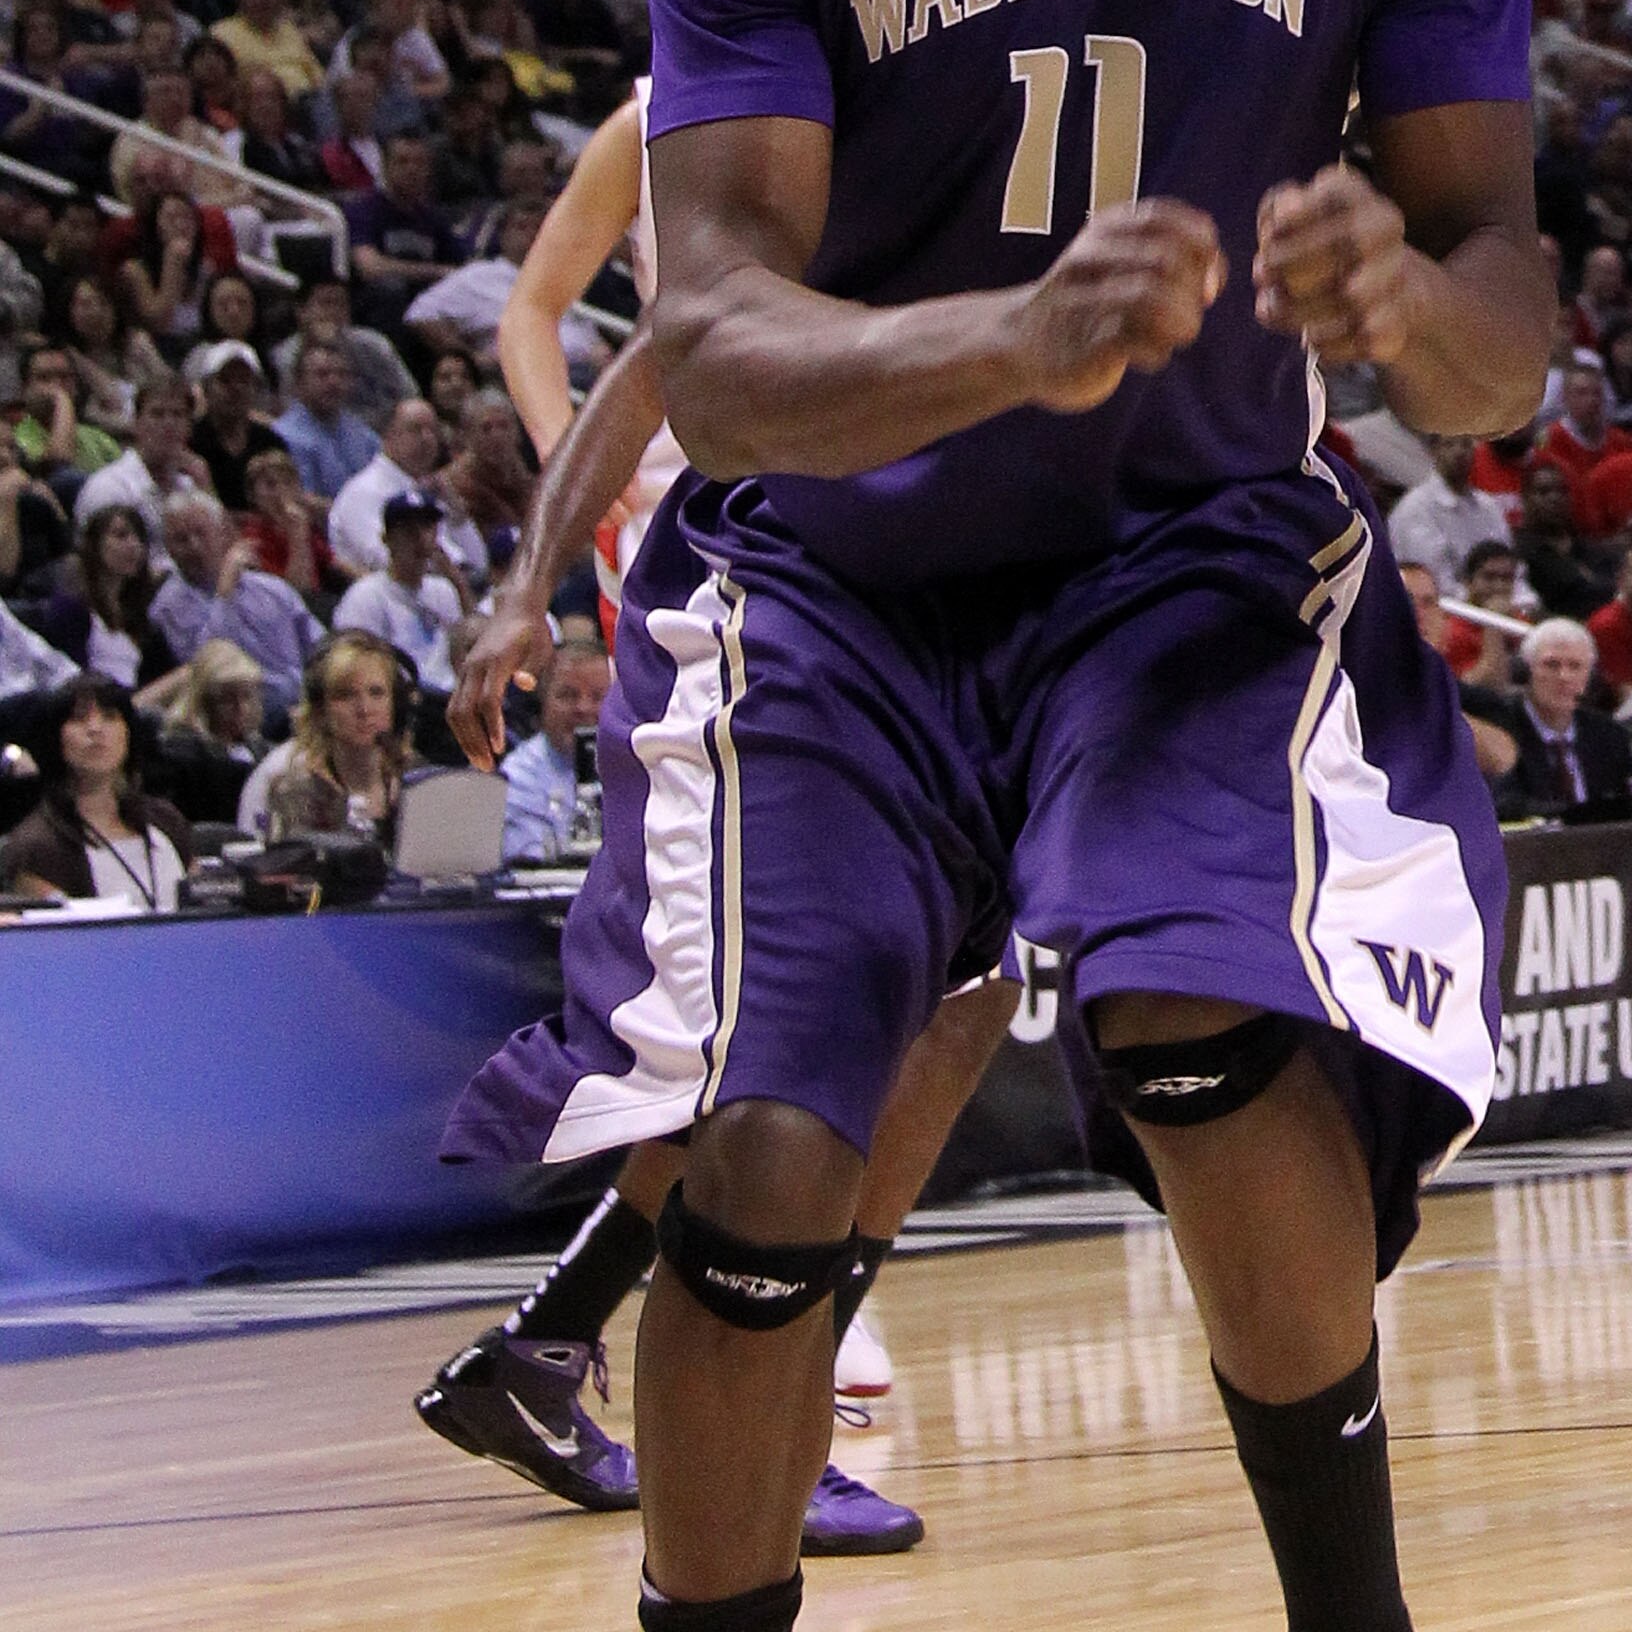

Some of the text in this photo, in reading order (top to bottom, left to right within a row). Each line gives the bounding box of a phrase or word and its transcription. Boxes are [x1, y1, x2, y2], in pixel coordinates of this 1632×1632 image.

[999, 33, 1147, 236] 11
[1354, 938, 1454, 1038] W
[1515, 879, 1625, 997] AND
[1494, 1003, 1611, 1101] STATE
